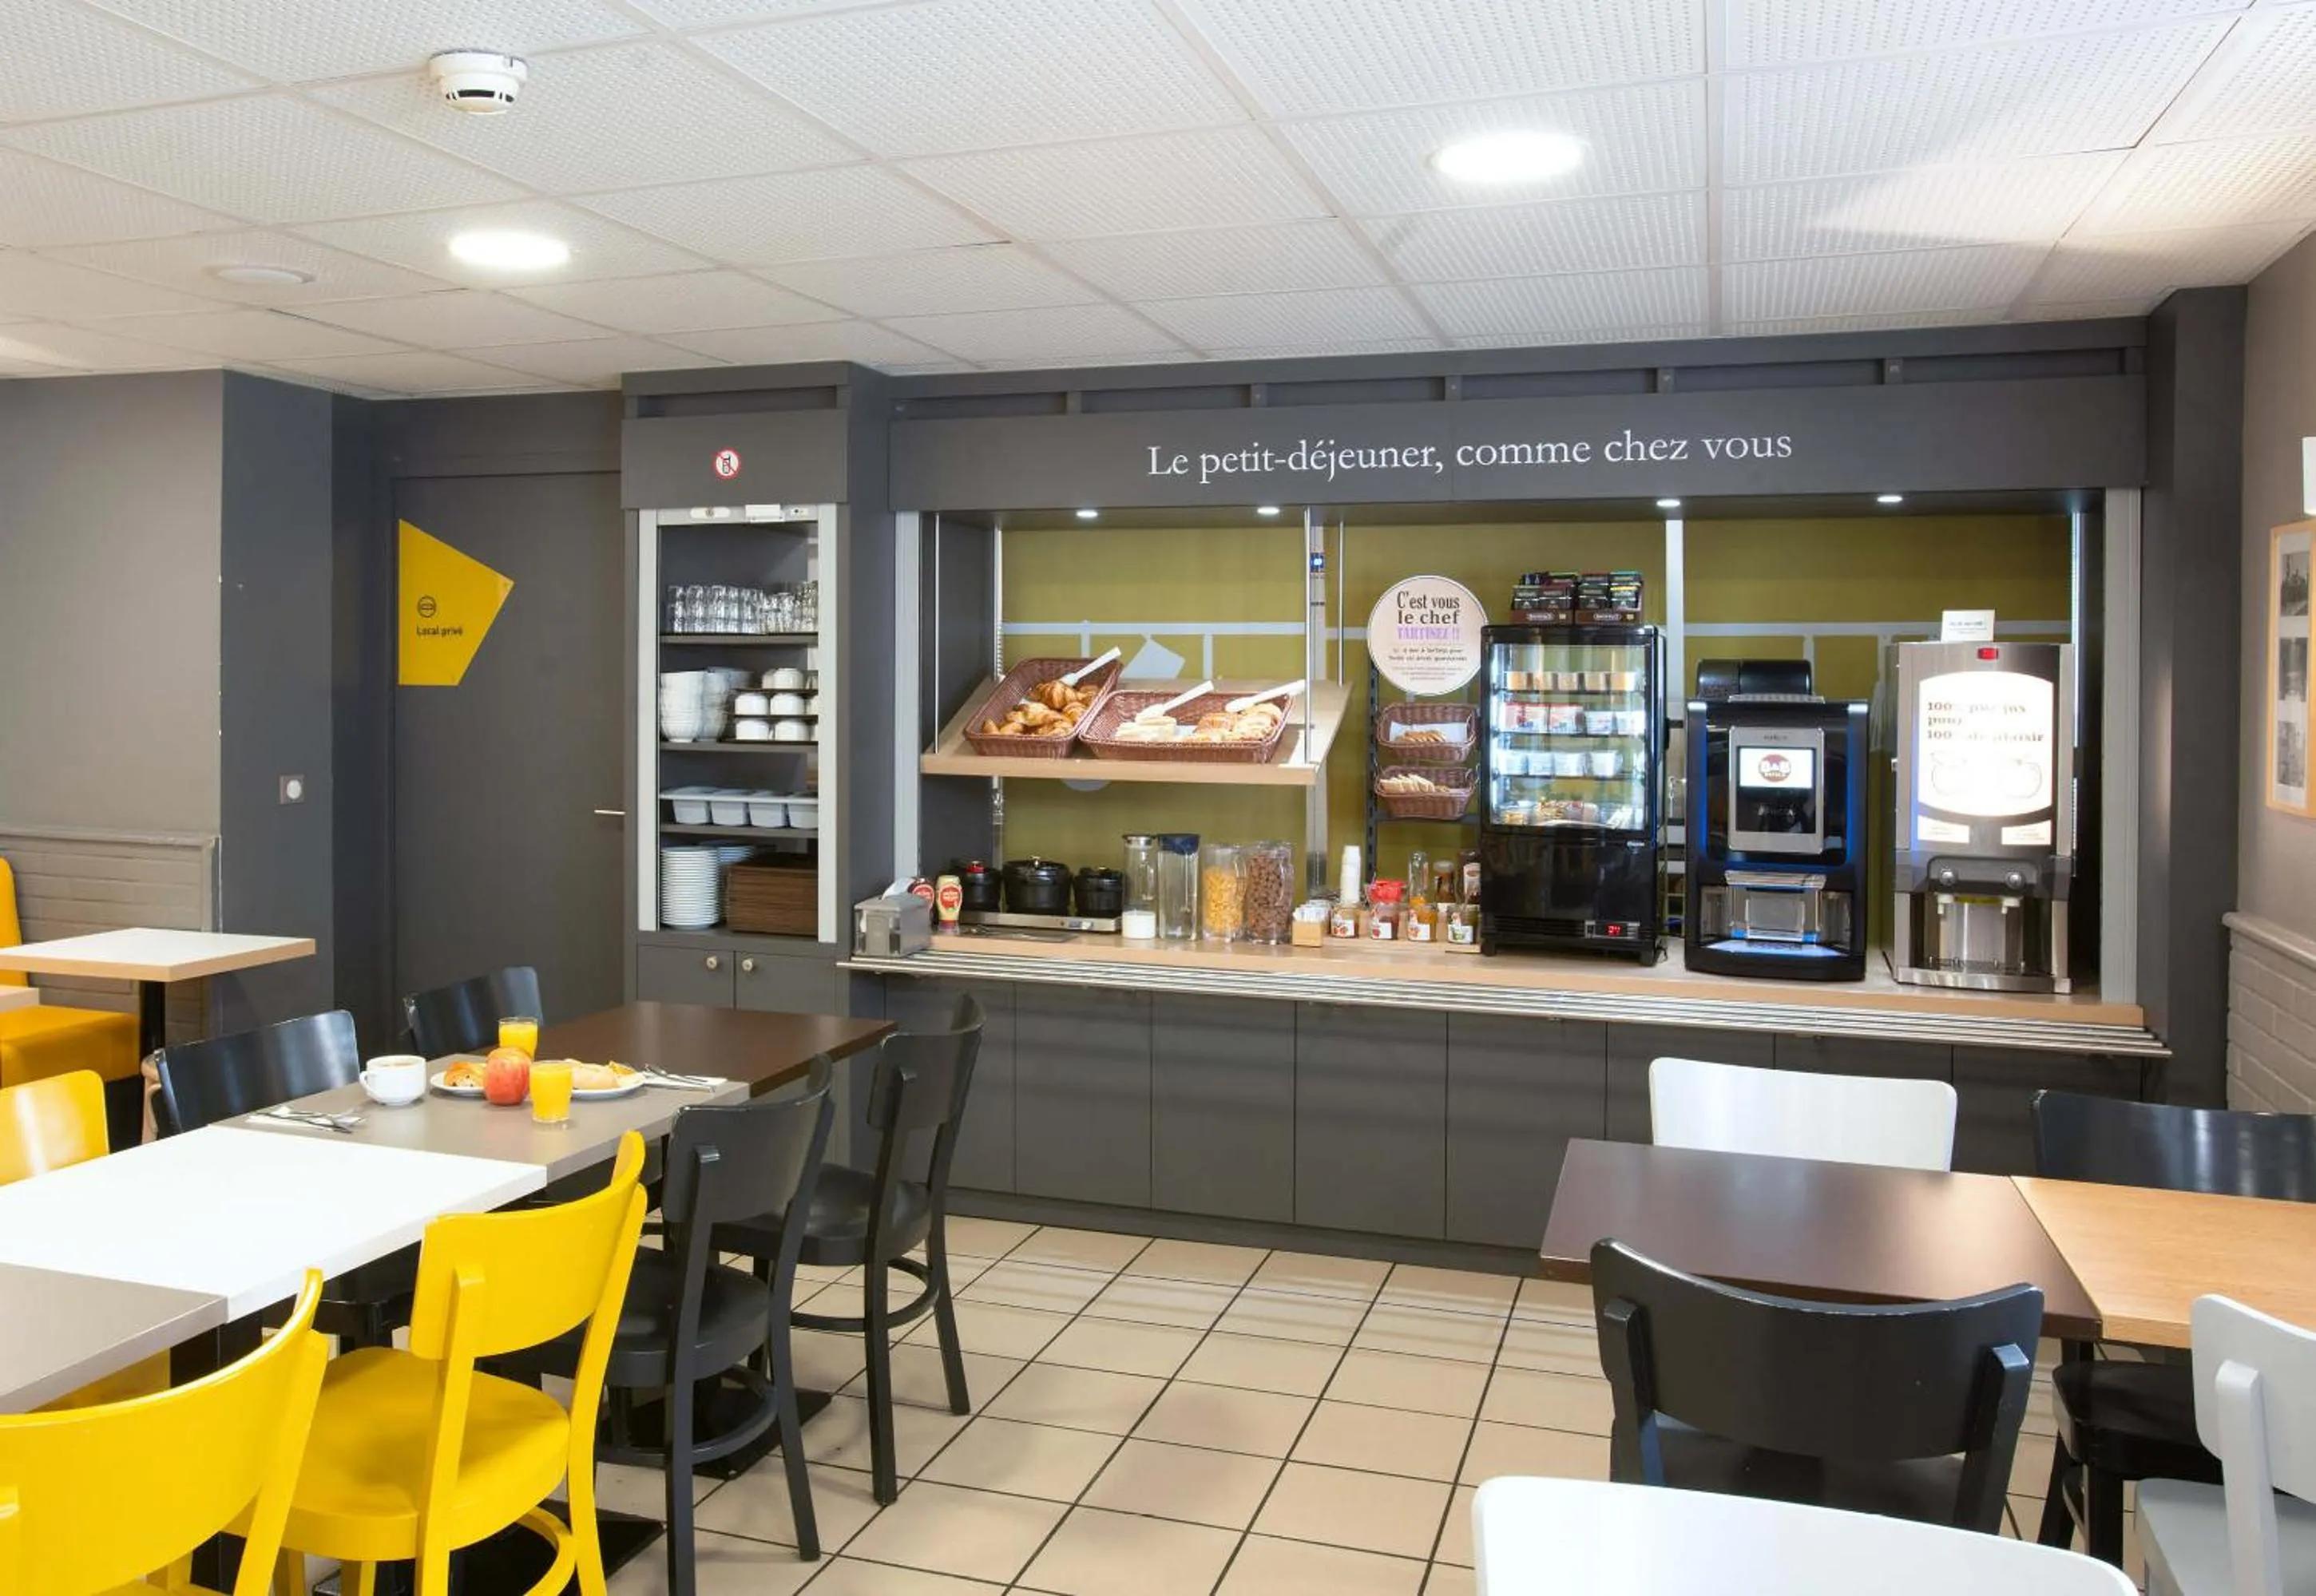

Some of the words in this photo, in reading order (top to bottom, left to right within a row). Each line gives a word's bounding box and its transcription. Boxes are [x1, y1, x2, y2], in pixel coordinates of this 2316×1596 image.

[1147, 446, 1189, 476] Le
[1199, 439, 1444, 485] petit-déjeuner,
[1456, 442, 1592, 467] comme
[1604, 429, 1689, 463] chez
[1701, 436, 1793, 461] vous
[1397, 591, 1428, 609] C'est
[1430, 596, 1461, 609] vous
[1398, 610, 1414, 624] le
[1419, 609, 1459, 624] chef
[416, 624, 439, 636] Local
